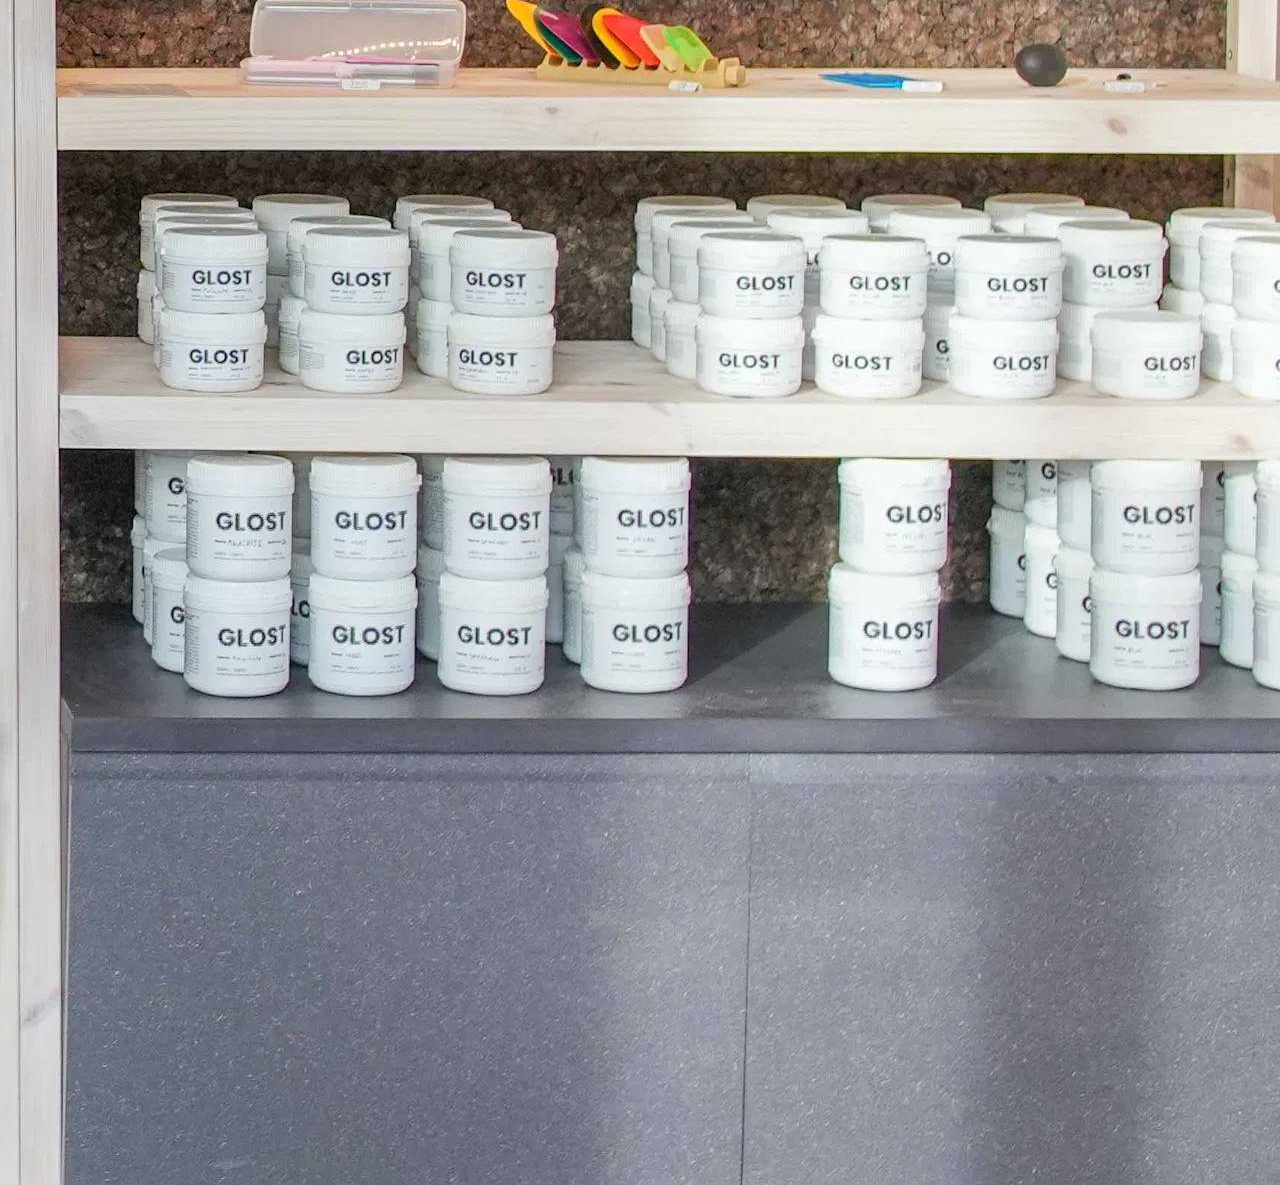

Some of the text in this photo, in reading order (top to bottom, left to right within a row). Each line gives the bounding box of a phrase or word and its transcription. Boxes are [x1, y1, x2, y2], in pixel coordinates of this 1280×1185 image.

[192, 270, 251, 285] GLOST
[332, 272, 390, 286] GLOST
[466, 272, 525, 288] GLOST
[1093, 265, 1150, 278] GLOST
[737, 276, 793, 290] GLOST
[849, 276, 911, 291] GLOST
[987, 278, 1049, 292] GLOST
[190, 349, 248, 364] GLOST
[347, 349, 398, 364] GLOST
[460, 349, 516, 366] GLOST
[718, 353, 781, 369] GLOST
[831, 354, 893, 371] GLOST
[993, 355, 1049, 371] GLOST
[1144, 355, 1197, 371] GLOST
[216, 512, 285, 531] GLOST
[334, 511, 407, 531] GLOST
[470, 511, 540, 530] GLOST
[617, 507, 685, 528] GLOST
[1123, 505, 1195, 524] GLOST
[219, 625, 285, 646] GLOST
[332, 625, 404, 645] GLOST
[458, 626, 530, 645] GLOST
[612, 622, 682, 643] GLOST
[863, 620, 933, 640] GLOST
[1115, 619, 1189, 640] GLOST
